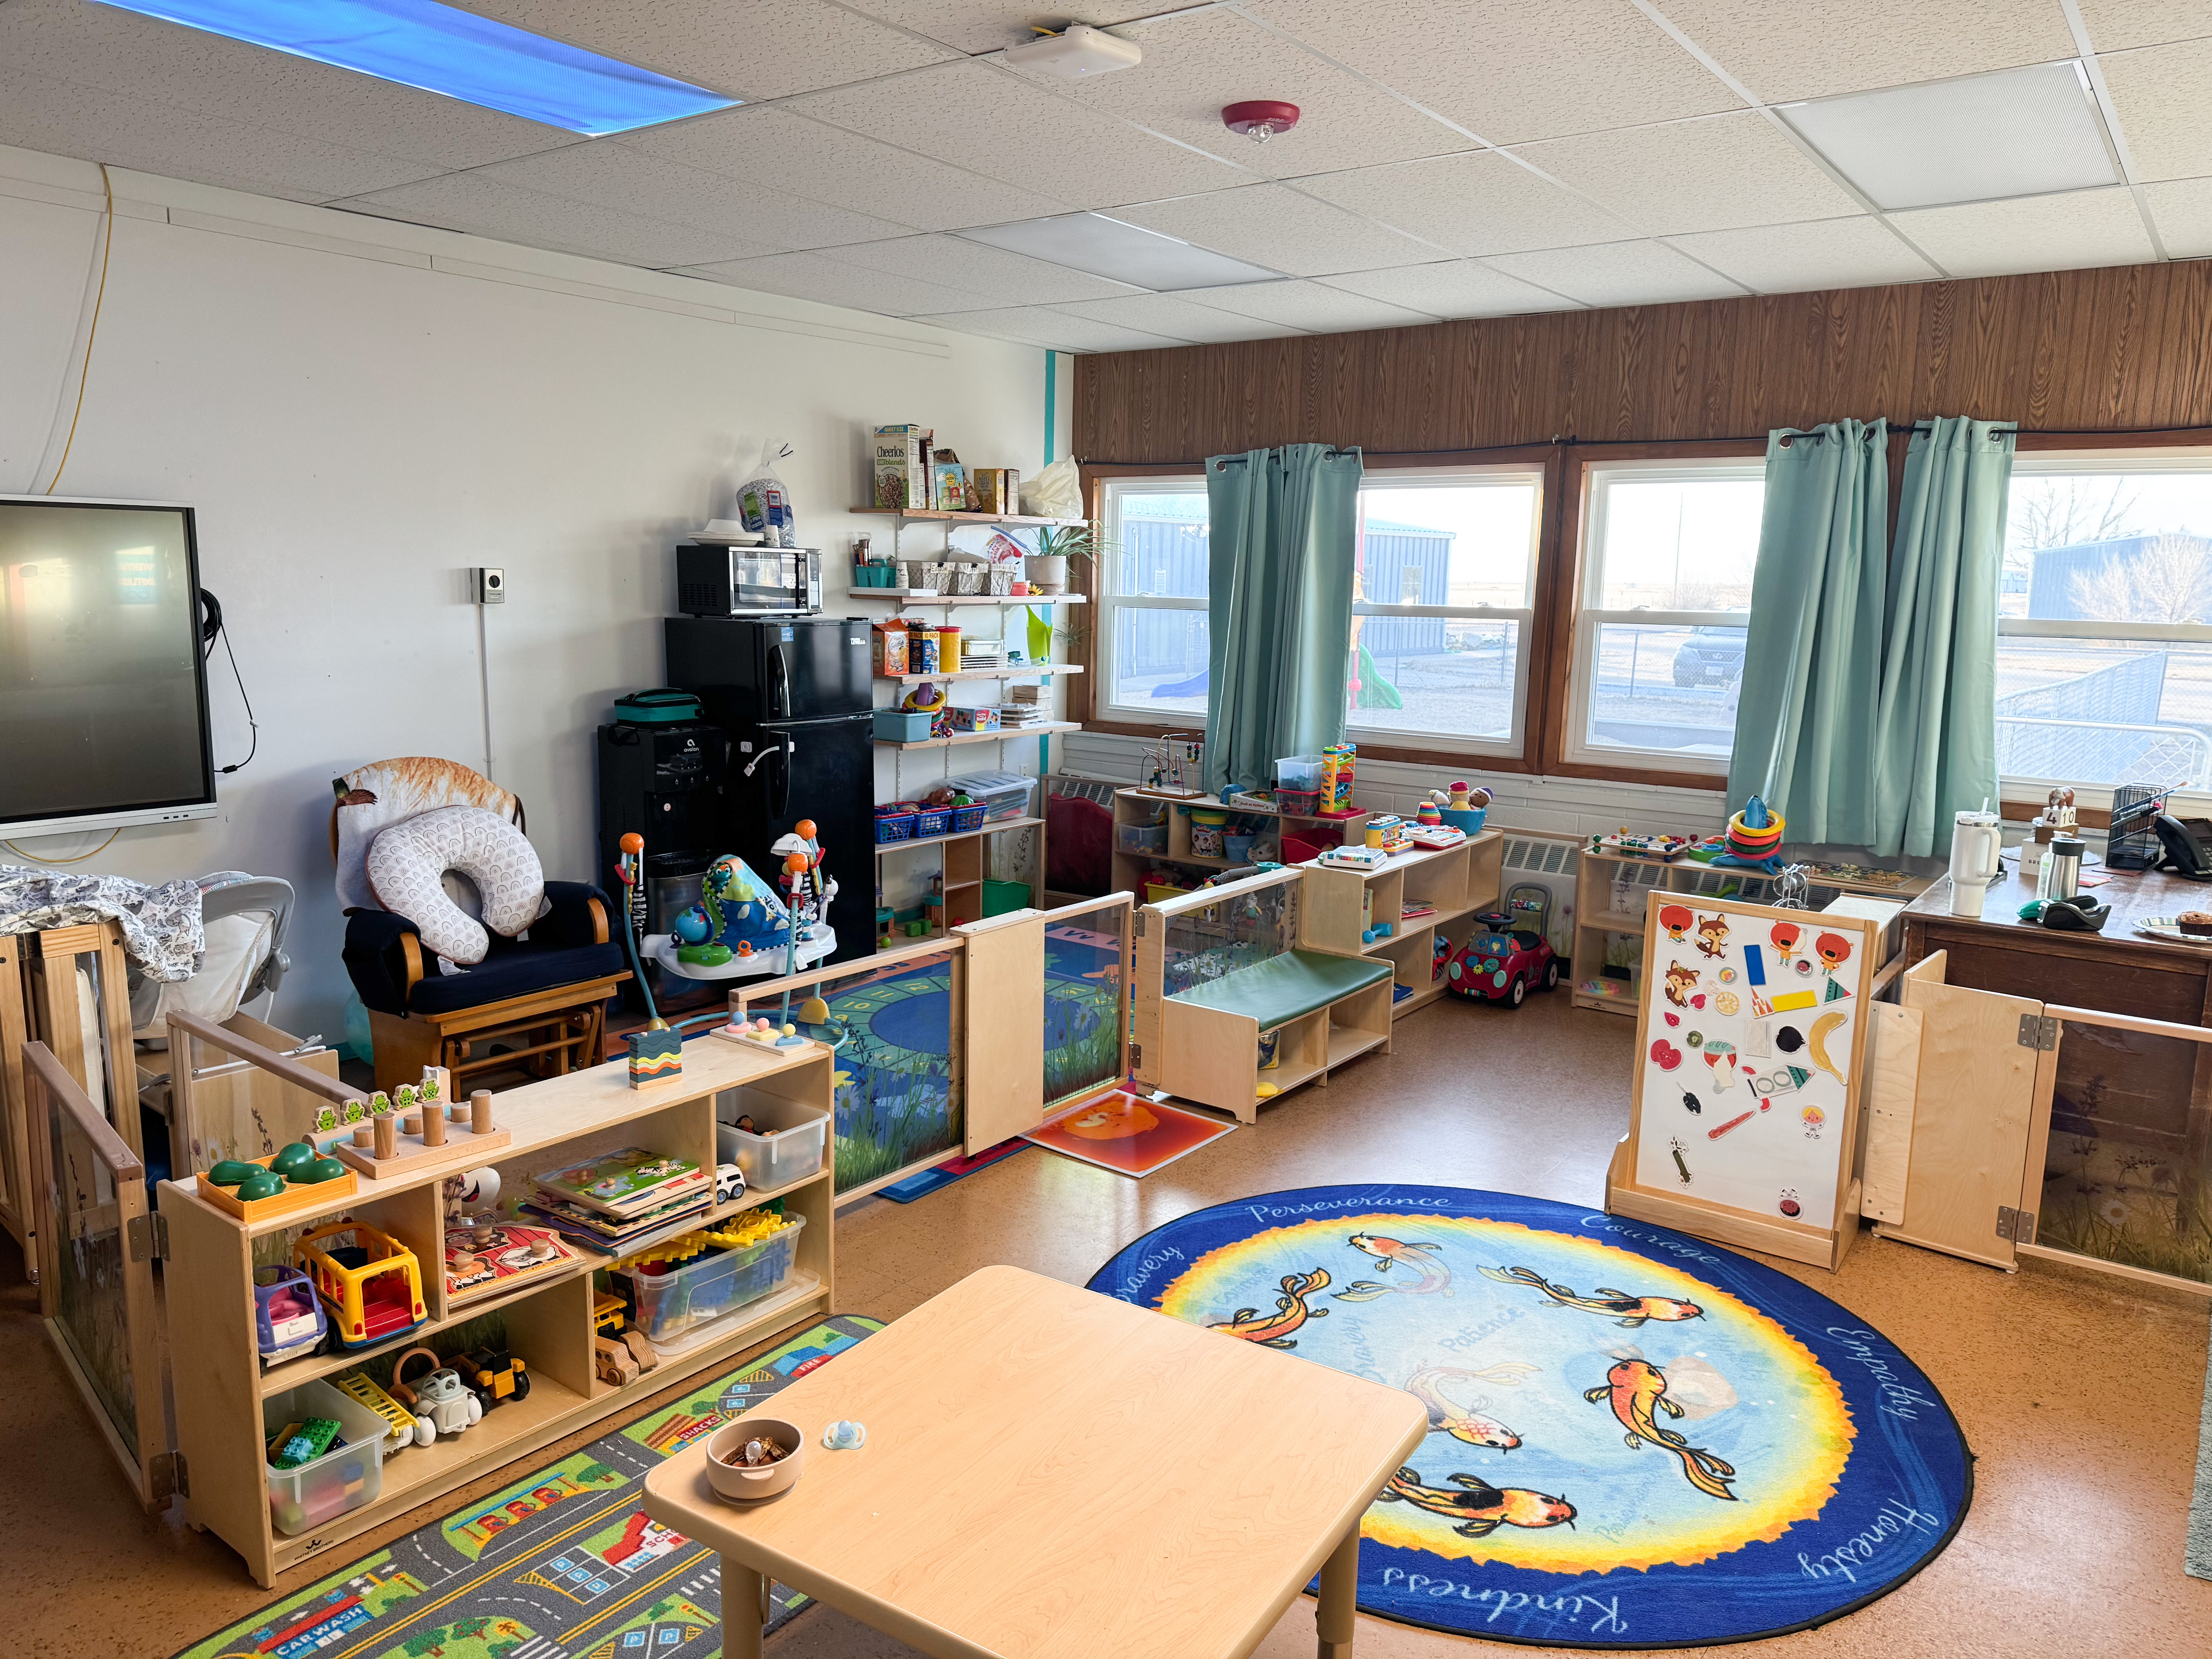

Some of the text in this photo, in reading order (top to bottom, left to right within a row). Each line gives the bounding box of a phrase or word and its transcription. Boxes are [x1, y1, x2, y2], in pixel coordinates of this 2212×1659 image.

[877, 445, 904, 457] Cheerios
[2046, 812, 2057, 824] 4
[2063, 811, 2074, 824] 10
[1245, 1196, 1452, 1223] Perseverance
[1580, 1215, 1721, 1264] Courage
[1438, 1307, 1525, 1353] Patience
[799, 1358, 821, 1371] FIRE
[1827, 1327, 1936, 1420] Empathy
[294, 1540, 334, 1560] WHITNEY BROTHERS
[1797, 1498, 1939, 1583] Honesty
[1383, 1567, 1628, 1634] Kindness
[277, 1607, 363, 1656] CAR WASH
